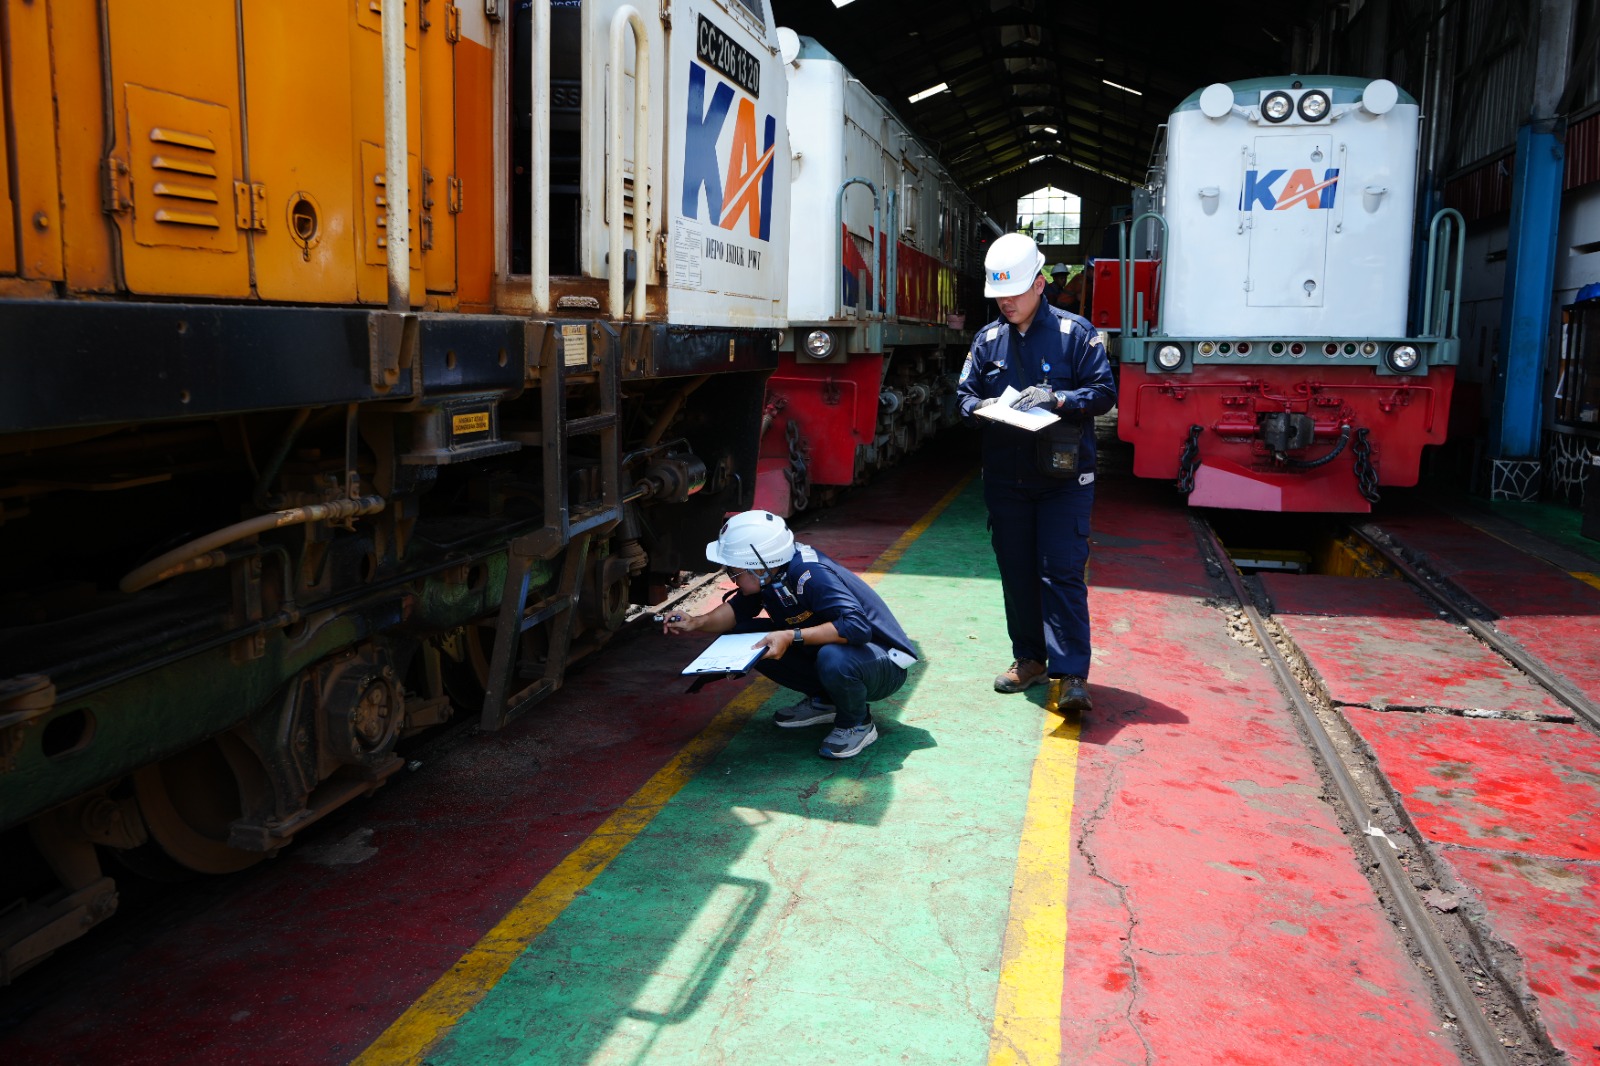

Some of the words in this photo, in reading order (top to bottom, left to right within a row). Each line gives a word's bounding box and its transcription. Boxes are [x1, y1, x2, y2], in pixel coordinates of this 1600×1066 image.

[700, 20, 716, 62] CC
[717, 34, 736, 77] 206
[738, 50, 747, 84] 13
[747, 58, 759, 92] 20
[682, 60, 776, 242] KAI
[1238, 168, 1341, 211] KAI
[705, 237, 724, 261] DEPO
